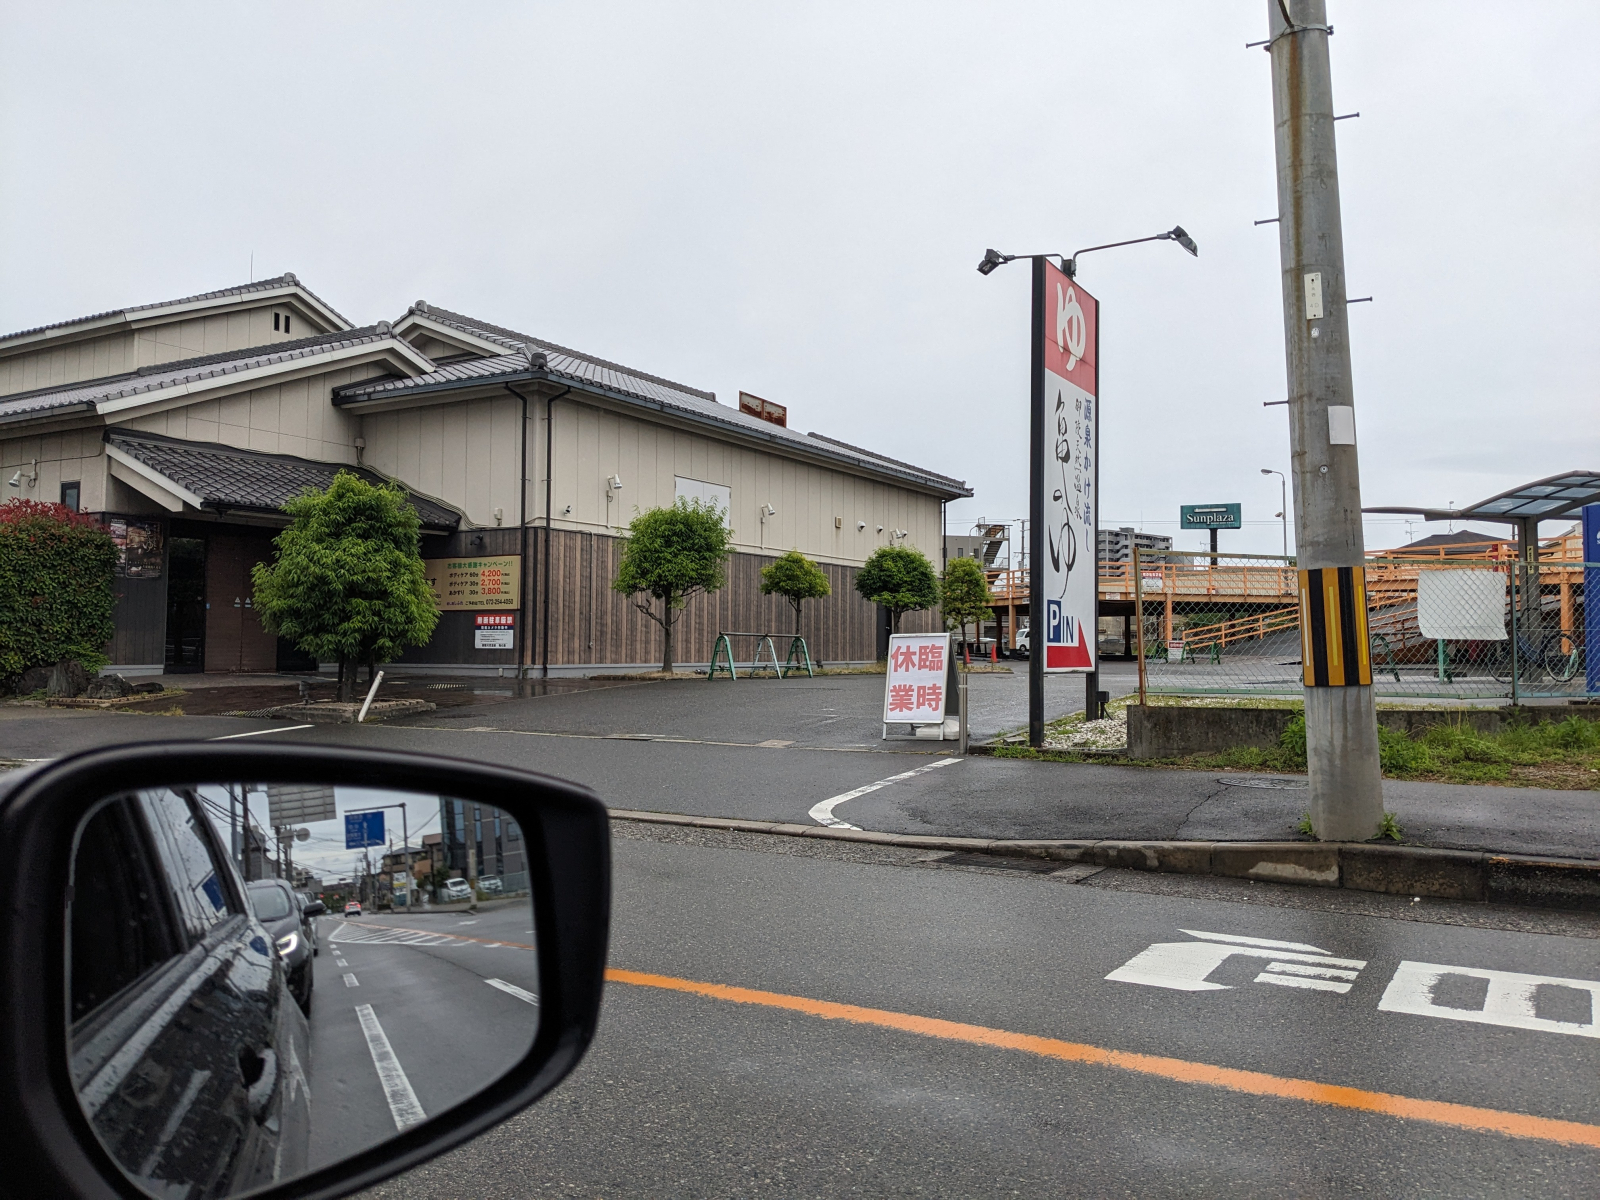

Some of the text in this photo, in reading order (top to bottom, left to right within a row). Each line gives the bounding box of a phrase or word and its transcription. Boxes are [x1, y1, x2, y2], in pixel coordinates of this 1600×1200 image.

[1057, 282, 1086, 371] ゆ
[1083, 397, 1093, 552] 源泉かけ流し
[1186, 513, 1234, 524] Sunplaza
[481, 570, 501, 578] 4,200
[481, 579, 501, 587] 2,700
[481, 587, 501, 595] 3,800
[888, 645, 917, 712] 休業
[917, 644, 944, 712] 臨時
